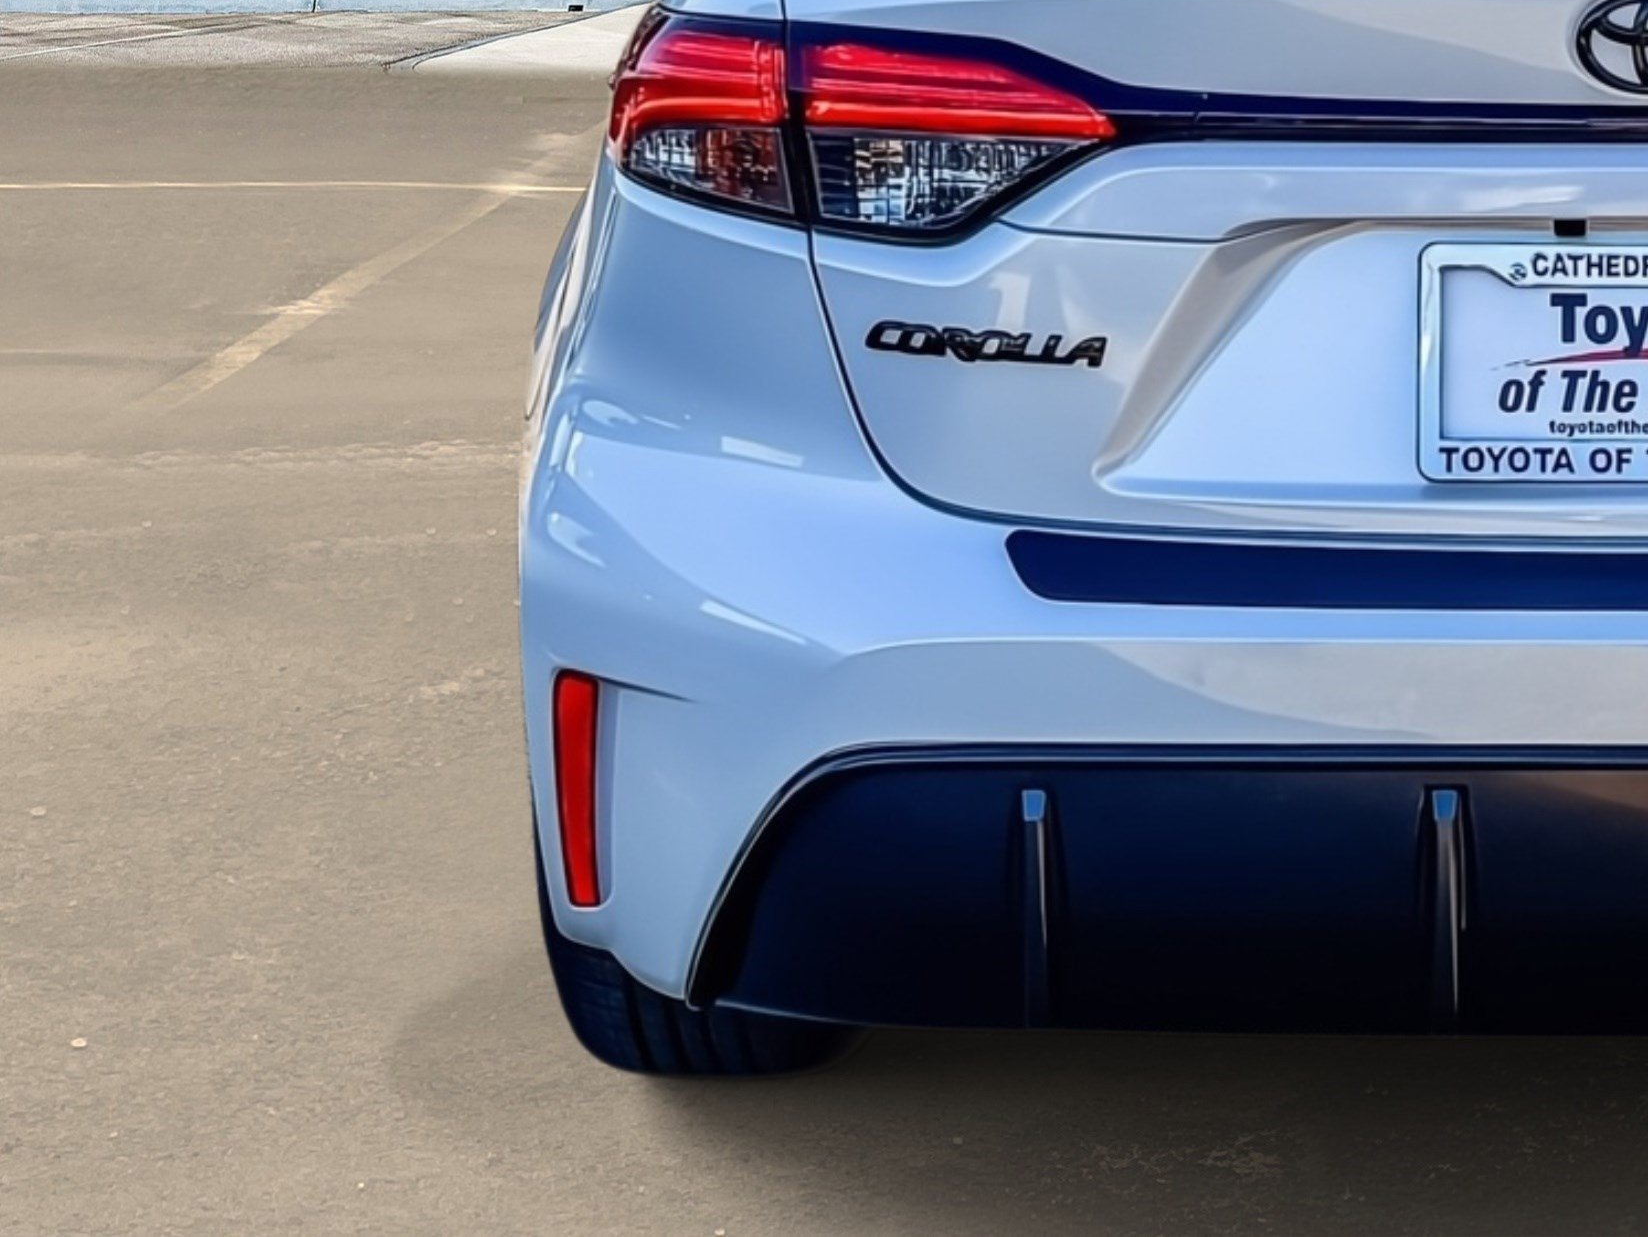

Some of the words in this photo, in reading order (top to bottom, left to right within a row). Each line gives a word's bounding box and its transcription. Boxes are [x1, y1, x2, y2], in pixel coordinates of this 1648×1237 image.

[865, 319, 1108, 368] COROLLA
[1498, 369, 1548, 413] of
[1560, 369, 1639, 414] The
[1438, 446, 1576, 474] TOYOTA
[1588, 447, 1633, 475] OF
